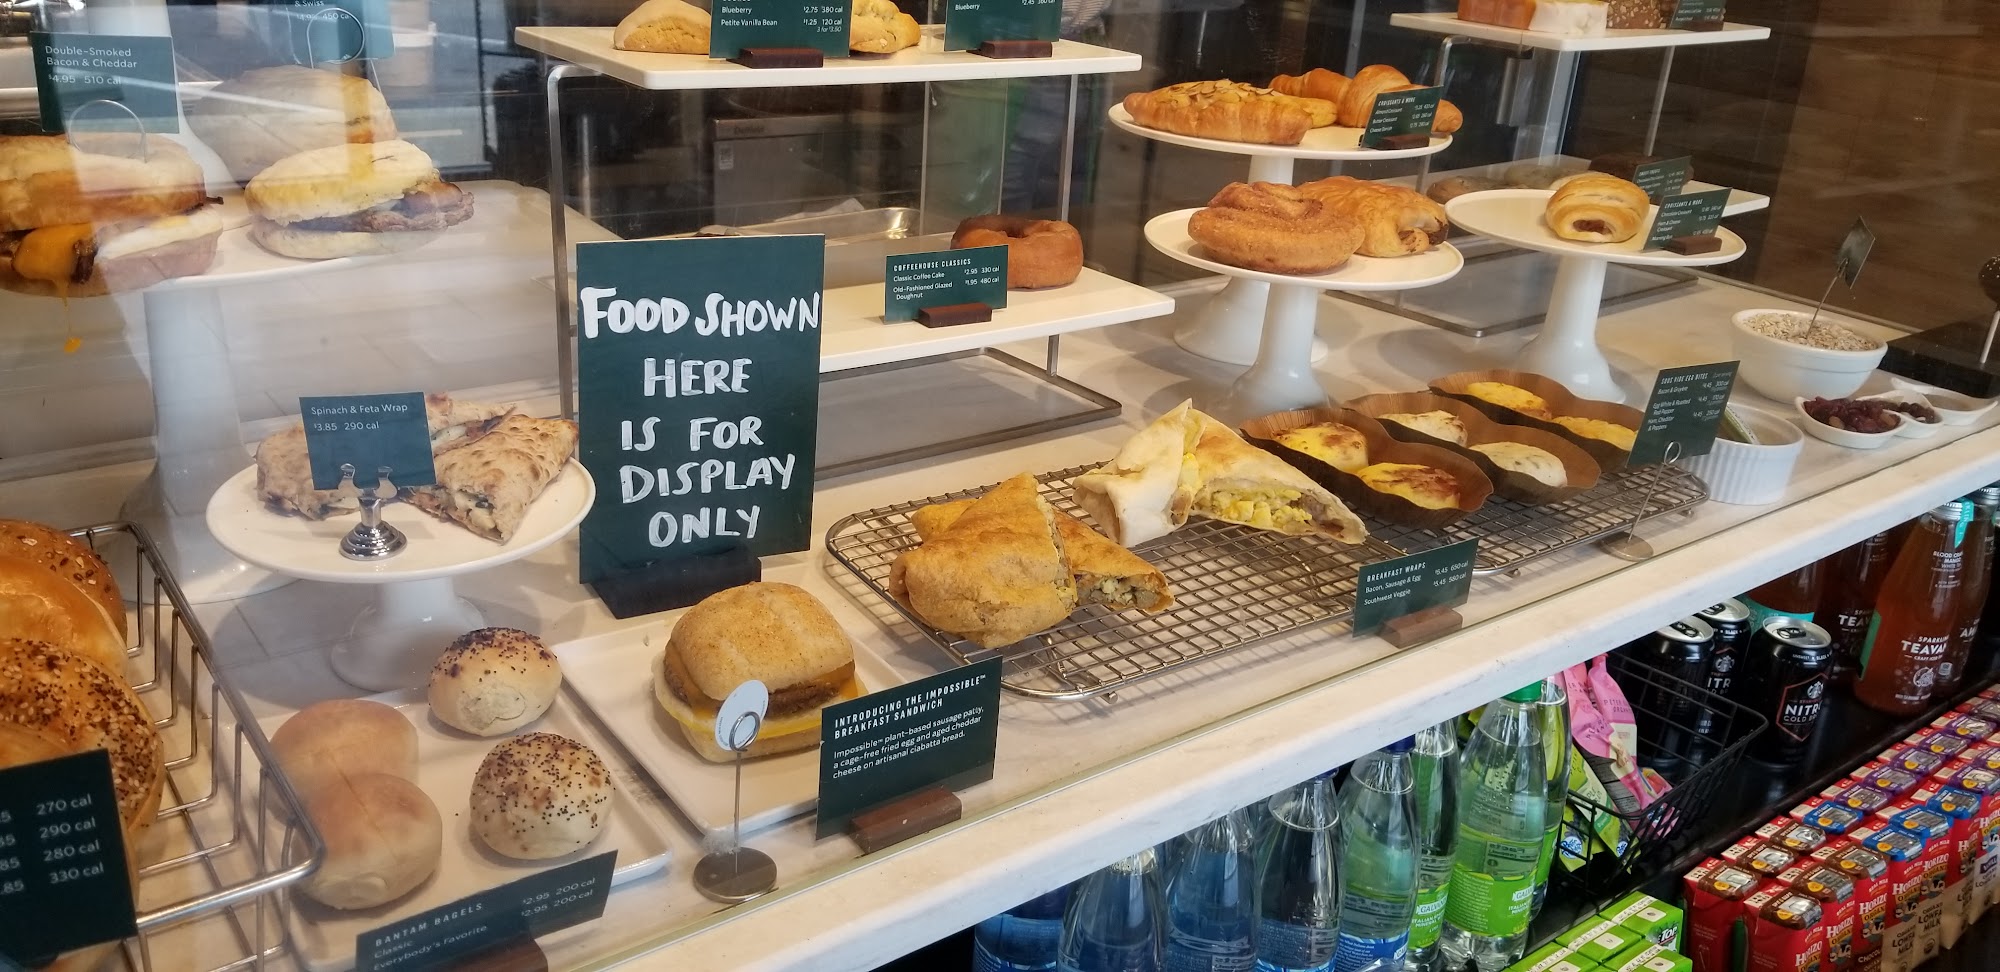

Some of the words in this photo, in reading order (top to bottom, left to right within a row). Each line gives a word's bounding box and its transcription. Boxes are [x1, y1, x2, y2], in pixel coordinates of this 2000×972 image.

[721, 6, 752, 14] Blueberry
[45, 46, 131, 57] Double-Smoked
[46, 57, 79, 66] Bacon
[82, 59, 90, 67] &
[93, 59, 137, 68] Cheddar
[48, 74, 76, 83] $4.95
[84, 76, 103, 84] 510
[107, 76, 121, 85] cal
[893, 262, 939, 271] COFFEEHOUSE
[942, 259, 971, 267] CLASSICS
[893, 284, 934, 293] Old-Fashioned
[896, 292, 923, 300] Doughnut
[580, 287, 690, 338] FOOD
[695, 291, 820, 337] SHOWN
[644, 358, 752, 397] HERE
[311, 406, 348, 417] Spinach
[350, 405, 357, 413] &
[360, 405, 380, 413] Feta
[381, 404, 408, 412] Wrap
[314, 423, 338, 431] $3.85
[344, 422, 364, 431] 290
[366, 421, 379, 429] cal
[621, 416, 661, 451] IS
[690, 416, 764, 451] FOR
[619, 454, 796, 503] DISPLAY
[648, 505, 760, 547] ONLY
[1933, 550, 1952, 558] BLOOD
[1365, 584, 1384, 593] Bacon,
[1385, 578, 1407, 589] Sausage
[1460, 561, 1469, 569] cal
[1366, 568, 1402, 582] BREAKFAST
[1405, 562, 1426, 573] WRAPS
[1364, 593, 1393, 605] Southwest
[1393, 588, 1411, 598] Veggie
[834, 715, 890, 740] BREAKFAST
[894, 698, 944, 721] SANDWICH
[835, 701, 902, 728] INTRODUCING
[905, 694, 922, 707] THE
[884, 722, 932, 744] plant-based
[932, 714, 962, 729] sausage
[963, 706, 984, 721] patty,
[833, 761, 839, 769] a
[840, 749, 880, 768] cage-free
[881, 741, 900, 754] fried
[901, 738, 915, 750] egg
[916, 731, 931, 743] and
[931, 725, 951, 739] aged
[951, 715, 982, 731] cheddar
[832, 764, 862, 779] cheese
[863, 761, 874, 770] on
[875, 748, 909, 766] artisanal
[909, 738, 941, 754] ciabatta
[942, 730, 966, 745] bread.
[37, 800, 67, 815] 270
[71, 793, 92, 808] cal
[40, 822, 71, 839] 290
[75, 816, 96, 831] cal
[43, 845, 75, 861] 280
[79, 839, 100, 854] cal
[49, 868, 80, 884] 330
[83, 861, 104, 876] cal
[374, 939, 414, 958] Classic
[522, 892, 550, 905] $2.95
[555, 882, 579, 896] 200
[581, 877, 596, 888] cal
[375, 922, 427, 947] BANTAM
[434, 902, 483, 926] BAGELS
[1924, 918, 1941, 932] MILK
[373, 941, 441, 971] Everybody's
[443, 925, 488, 945] Favorite
[521, 904, 548, 917] $2.95
[553, 894, 577, 907] 200
[579, 890, 594, 900] cal
